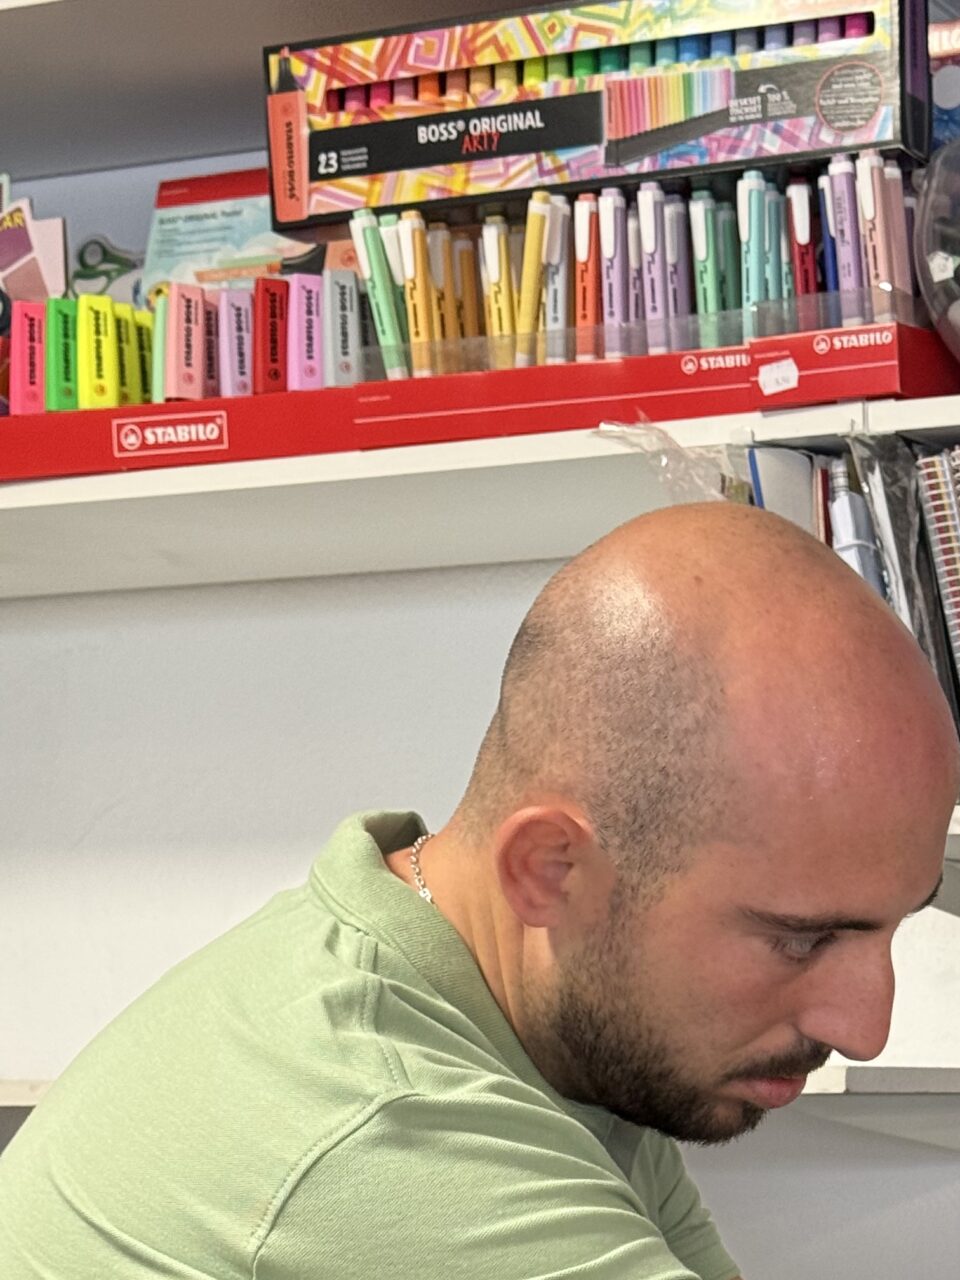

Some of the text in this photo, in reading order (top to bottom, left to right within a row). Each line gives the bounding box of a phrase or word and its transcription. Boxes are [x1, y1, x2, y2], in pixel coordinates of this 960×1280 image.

[469, 110, 545, 134] ORIGINAL
[462, 131, 501, 154] ARTY
[317, 150, 339, 175] 23
[832, 330, 893, 350] STABILO
[143, 422, 220, 447] STABILO
